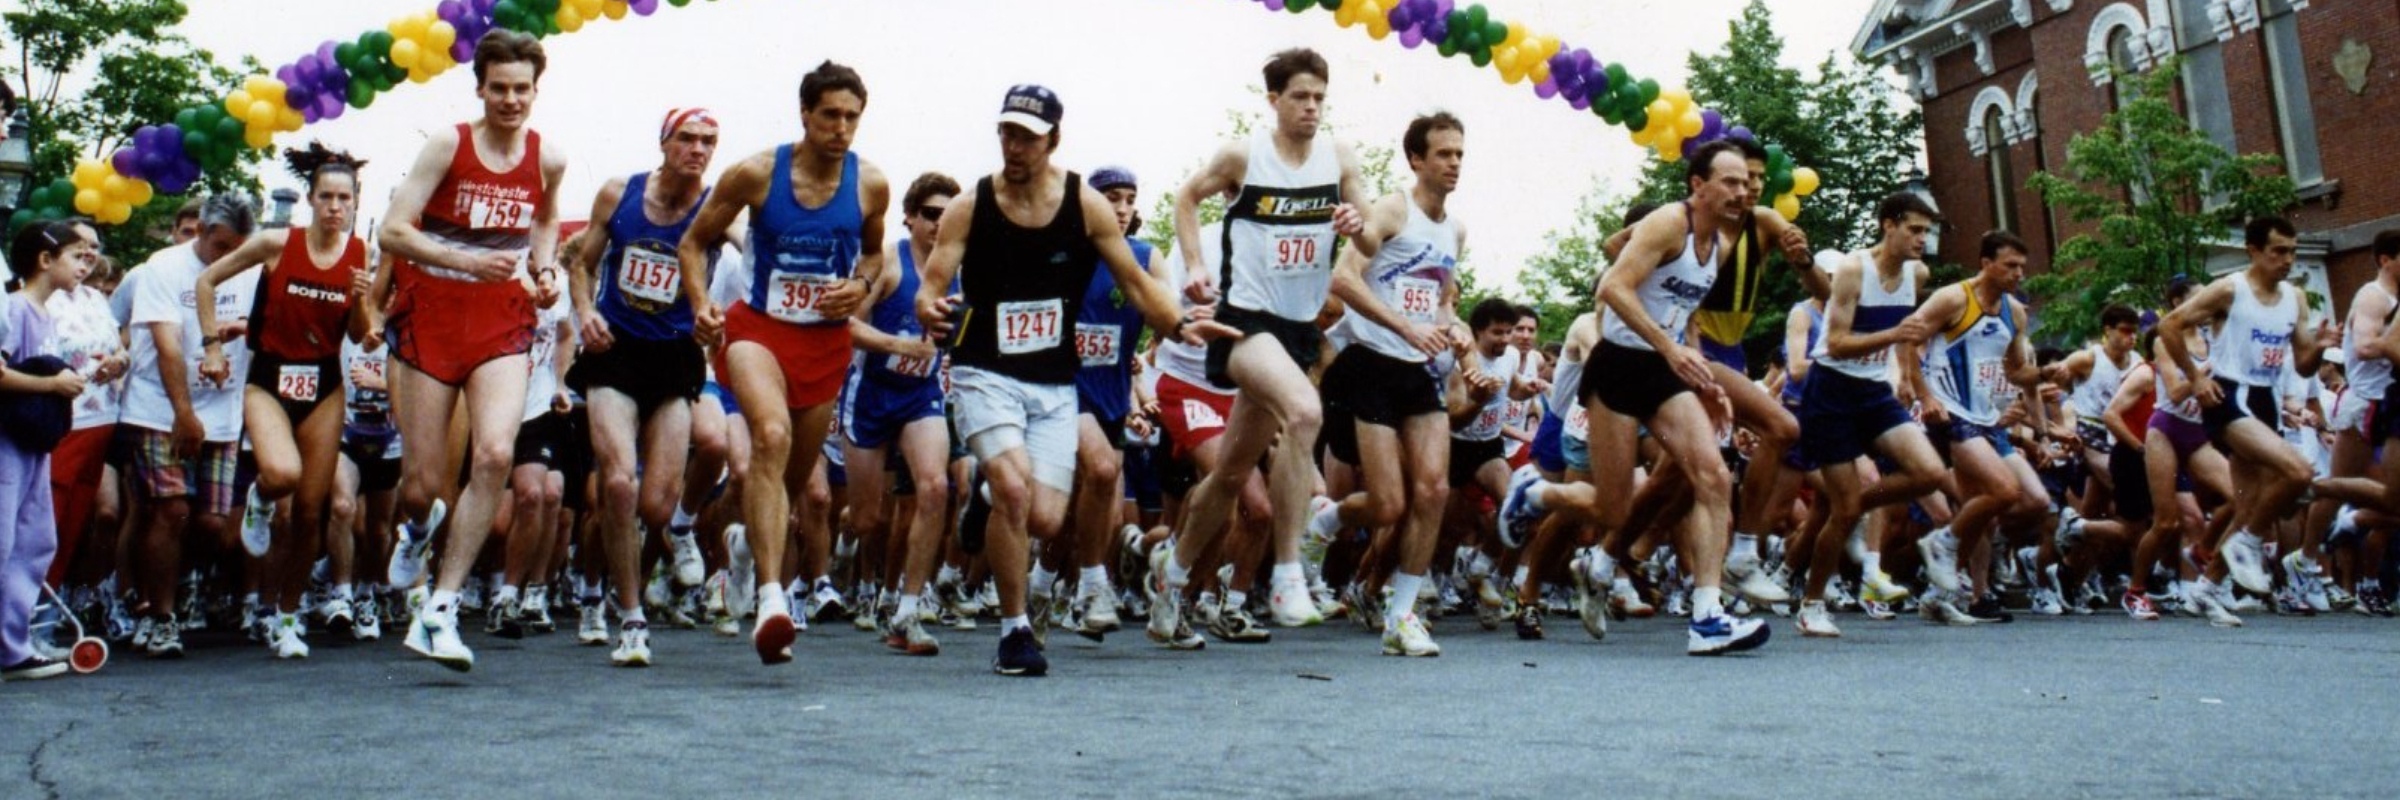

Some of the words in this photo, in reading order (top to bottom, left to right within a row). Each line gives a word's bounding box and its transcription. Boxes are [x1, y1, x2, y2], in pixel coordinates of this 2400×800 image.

[483, 200, 521, 227] 759
[1279, 238, 1315, 264] 970
[627, 258, 677, 291] 1157
[286, 283, 347, 304] BOSTON
[782, 282, 826, 310] 392
[1403, 288, 1430, 312] 955
[1005, 311, 1057, 341] 1247
[1075, 333, 1111, 356] 853
[280, 375, 317, 399] 285
